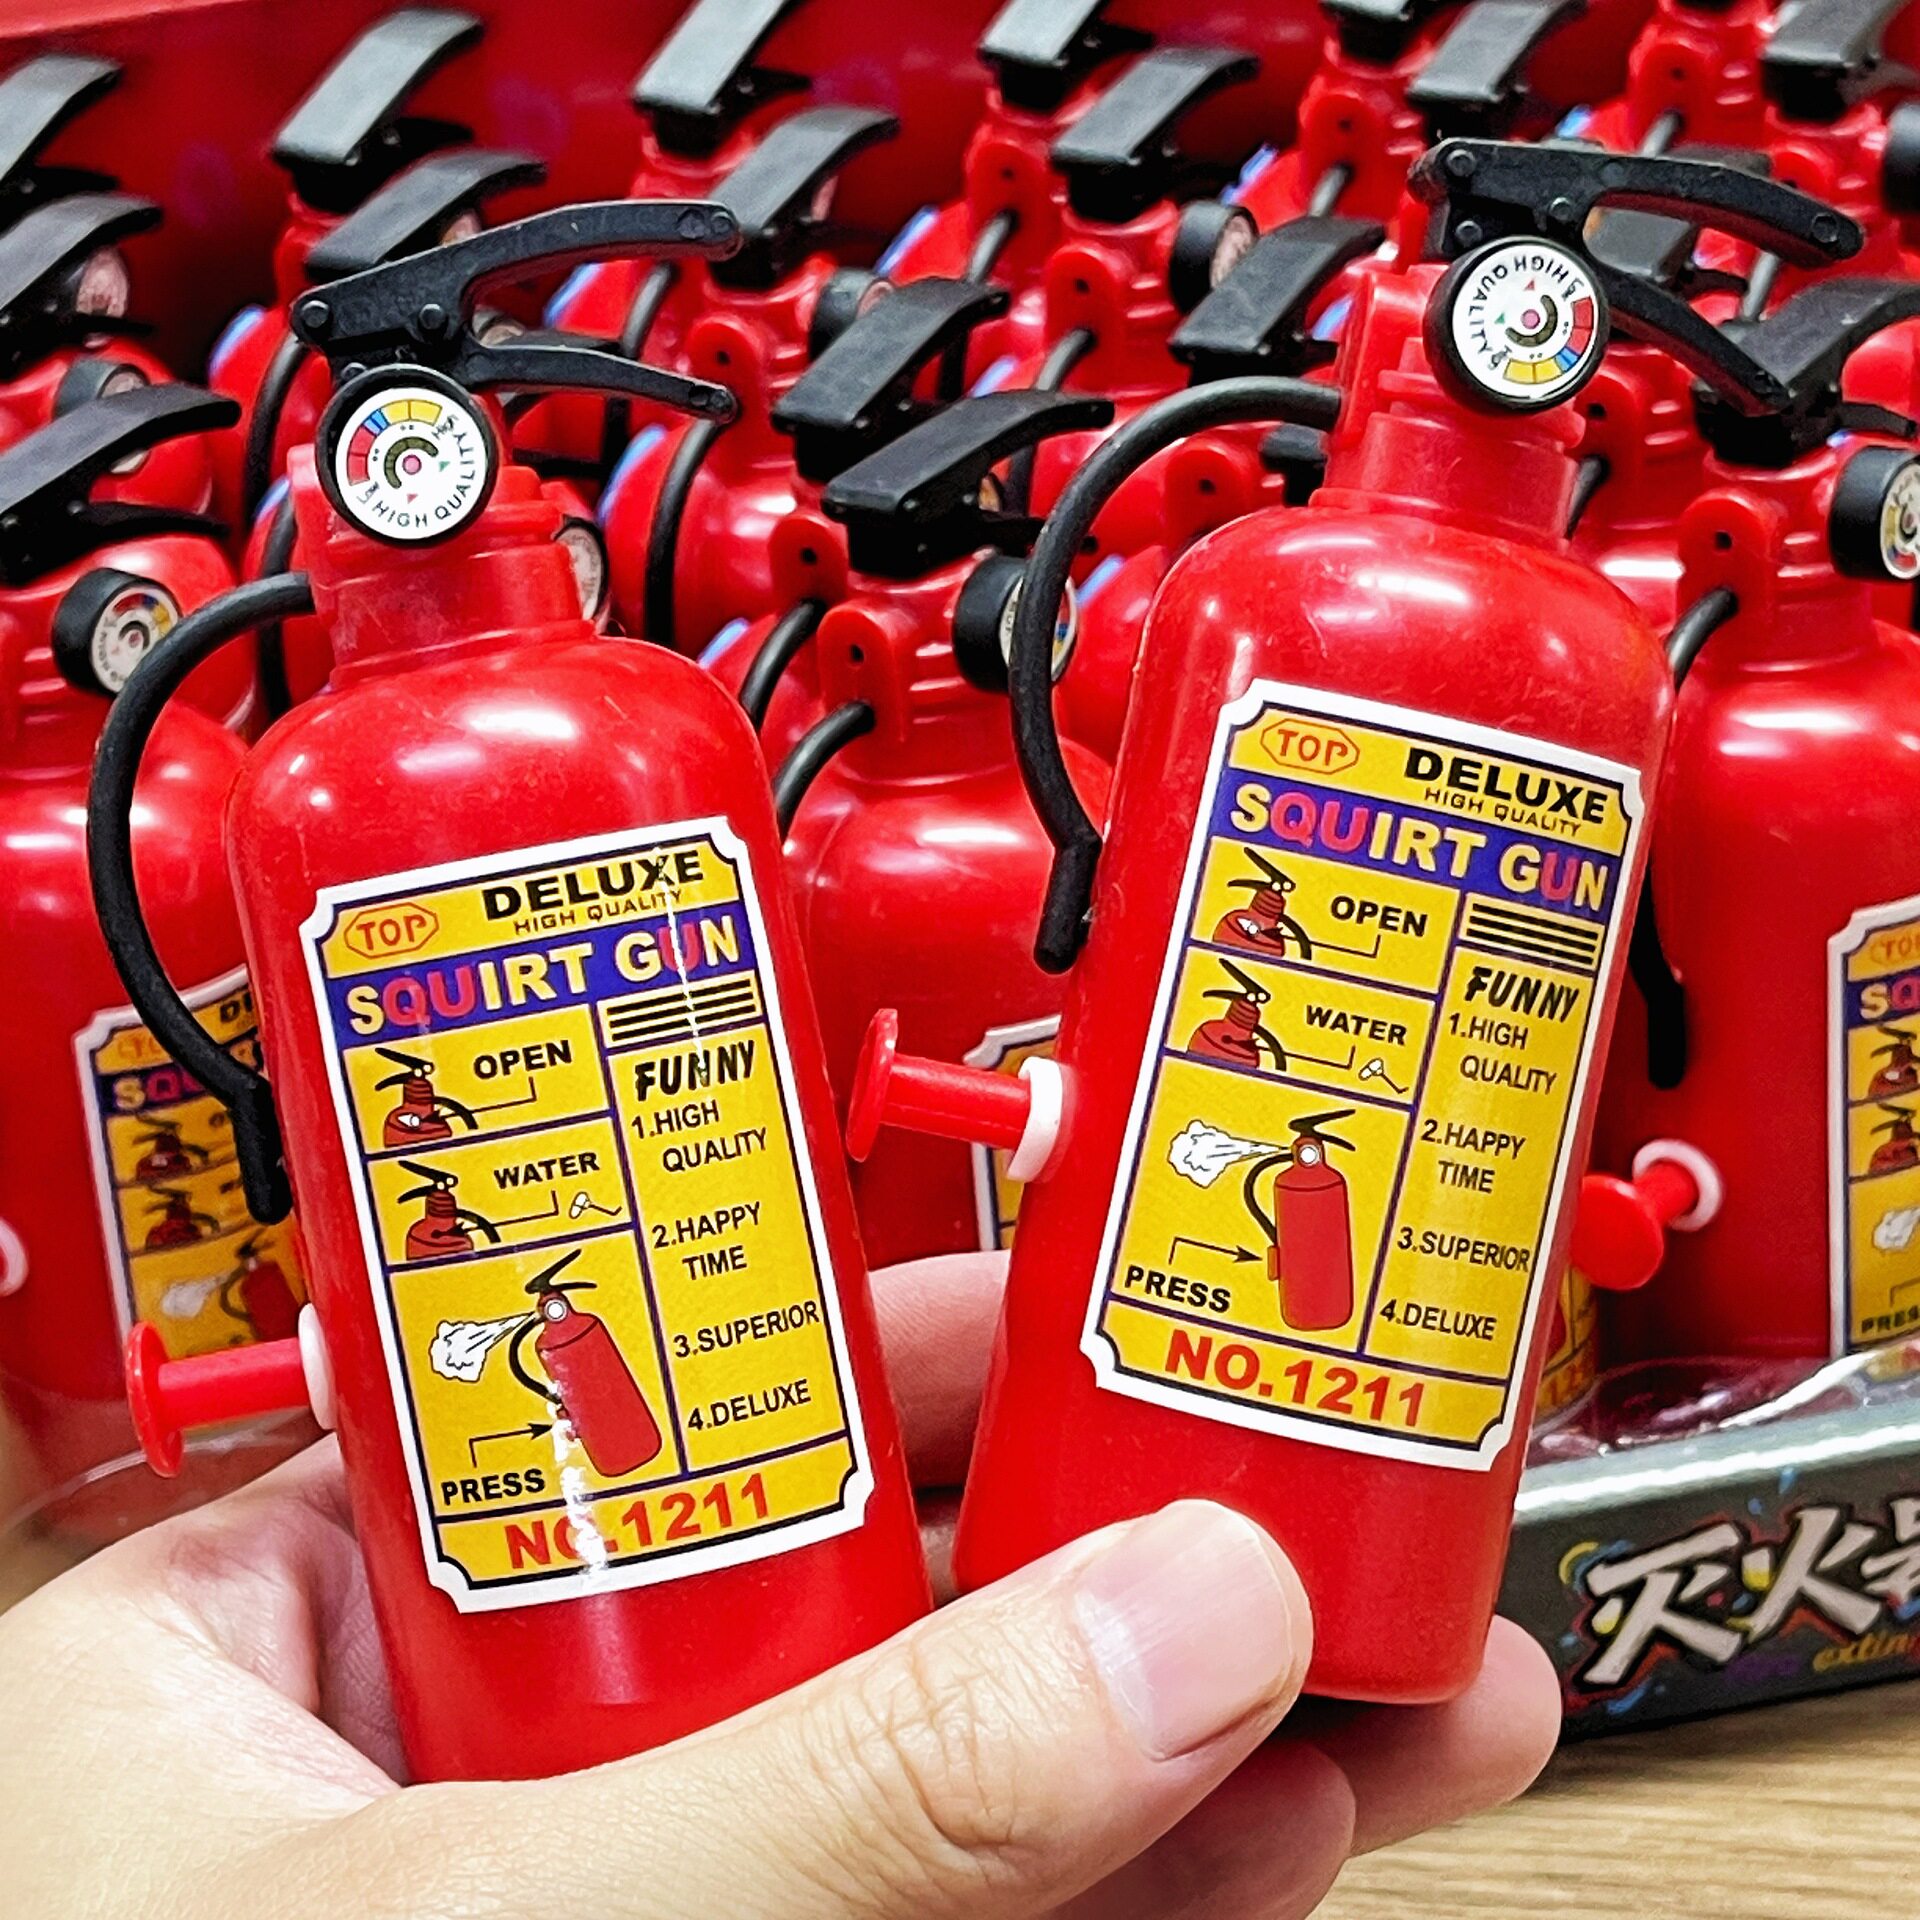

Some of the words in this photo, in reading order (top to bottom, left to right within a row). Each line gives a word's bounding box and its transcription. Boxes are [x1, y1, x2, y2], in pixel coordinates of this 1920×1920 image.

[1514, 254, 1569, 283] HIGH
[1468, 263, 1508, 354] QUALITY
[372, 500, 428, 528] HIGH
[435, 431, 475, 520] QUALITY
[1277, 728, 1348, 767] TOP
[1405, 748, 1608, 824] DELUXE
[1424, 787, 1483, 814] HIGH
[1493, 804, 1582, 837] QUALITY
[1230, 784, 1487, 878] SQUIRT
[1500, 845, 1608, 911] GUN
[482, 850, 704, 921] DELUXE
[356, 914, 427, 951] TOP
[514, 910, 576, 935] HIGH
[587, 890, 683, 923] QUALITY
[1330, 896, 1428, 937] OPEN
[1881, 933, 1920, 960] TO
[349, 942, 593, 1035] SQUIRT
[615, 914, 740, 983] GUN
[1464, 966, 1579, 1024] FUNNY
[1305, 1005, 1407, 1046] WATER
[1449, 1012, 1529, 1050] 1.HIGH
[473, 1039, 572, 1080] OPEN
[635, 1039, 754, 1102] FUNNY
[1460, 1055, 1557, 1095] QUALITY
[631, 1099, 719, 1139] 1.HIGH
[1421, 1119, 1526, 1160] 2.HAPPY
[493, 1151, 600, 1189] WATER
[662, 1126, 767, 1172] QUALITY
[1438, 1161, 1495, 1194] TIME
[652, 1201, 761, 1249] 2.HAPPY
[683, 1245, 748, 1281] TIME
[1397, 1227, 1531, 1273] 3.SUPERIOR
[1124, 1265, 1231, 1313] PRESS
[674, 1300, 821, 1359] 3.SUPERIOR
[1379, 1299, 1498, 1341] 4.DELUXE
[1164, 1328, 1426, 1427] NO.1211
[687, 1378, 811, 1432] 4.DELUXE
[441, 1468, 546, 1506] PRESS
